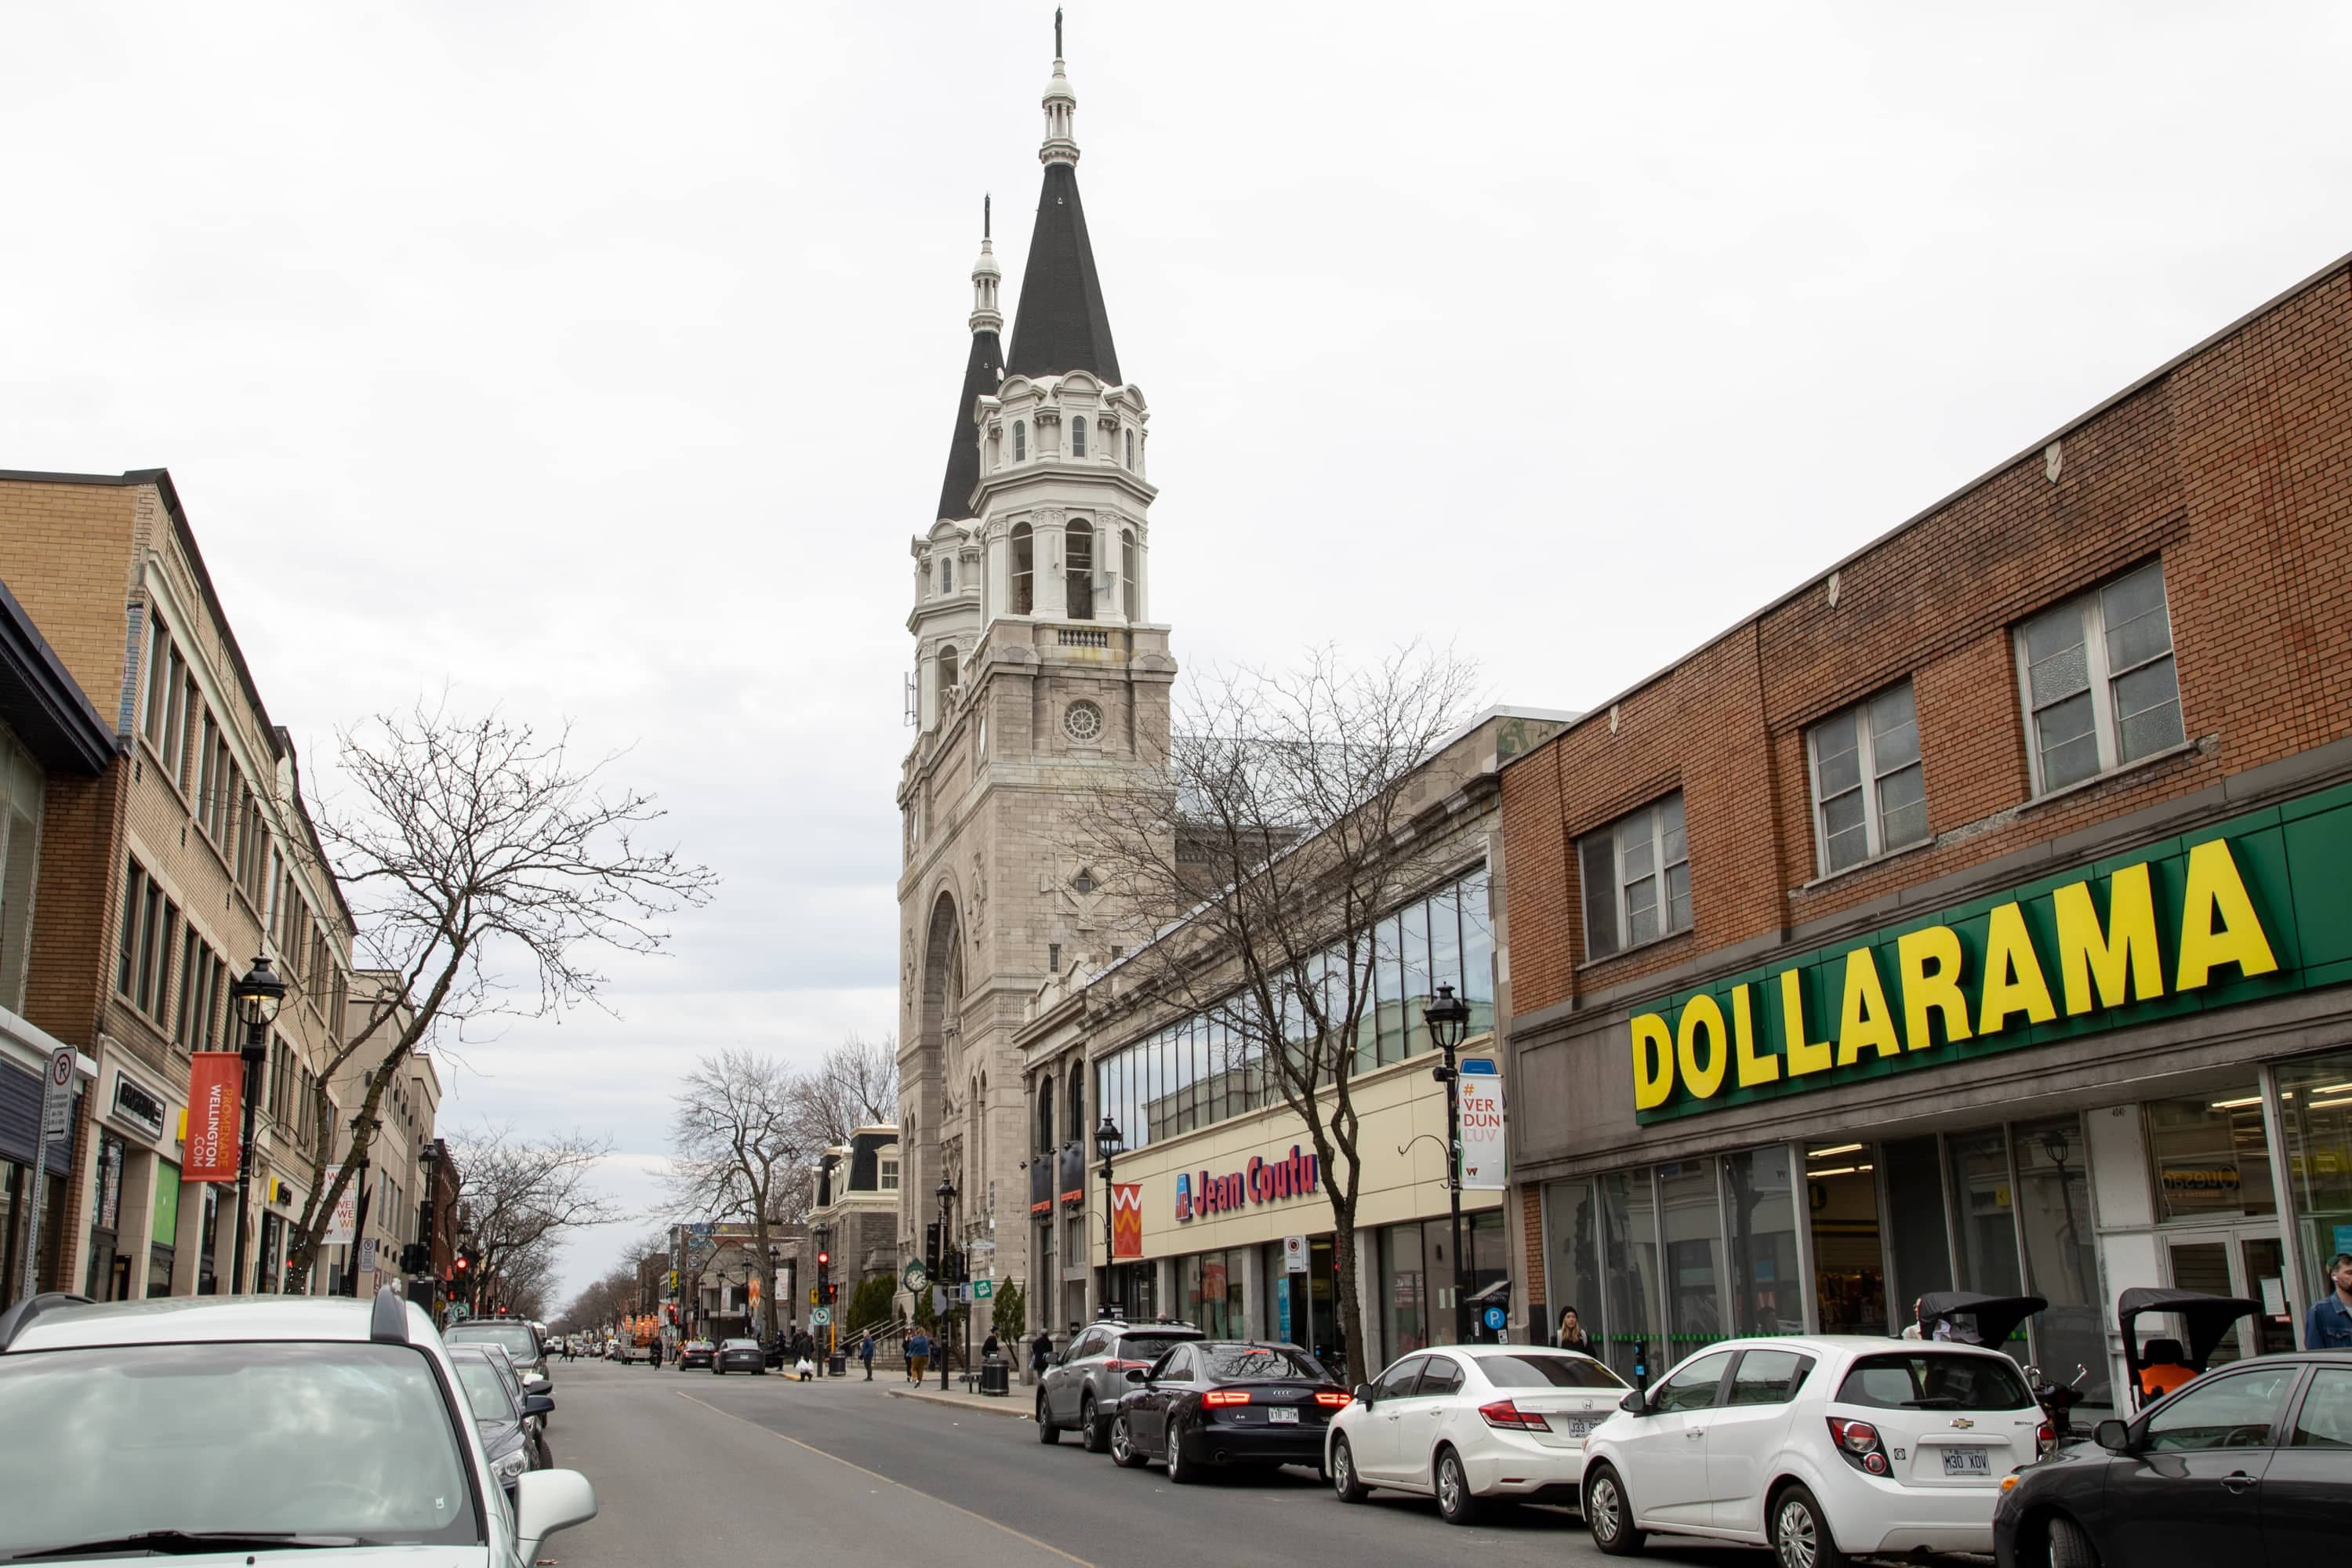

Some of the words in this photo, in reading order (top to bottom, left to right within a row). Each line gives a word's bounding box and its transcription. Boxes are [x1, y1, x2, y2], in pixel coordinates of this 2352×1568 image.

[1630, 838, 2278, 1110] DOLLARAMA
[1463, 1083, 1475, 1096] #
[1464, 1098, 1496, 1112] VER
[205, 1084, 221, 1167] WELLINGTON
[218, 1088, 233, 1167] PROMENADE
[1464, 1113, 1501, 1127] DUN
[1465, 1129, 1497, 1142] LUV
[193, 1134, 205, 1167] .COM
[1193, 1171, 1244, 1217] Jean
[1247, 1145, 1318, 1203] Coutu
[1571, 1422, 1585, 1432] J33
